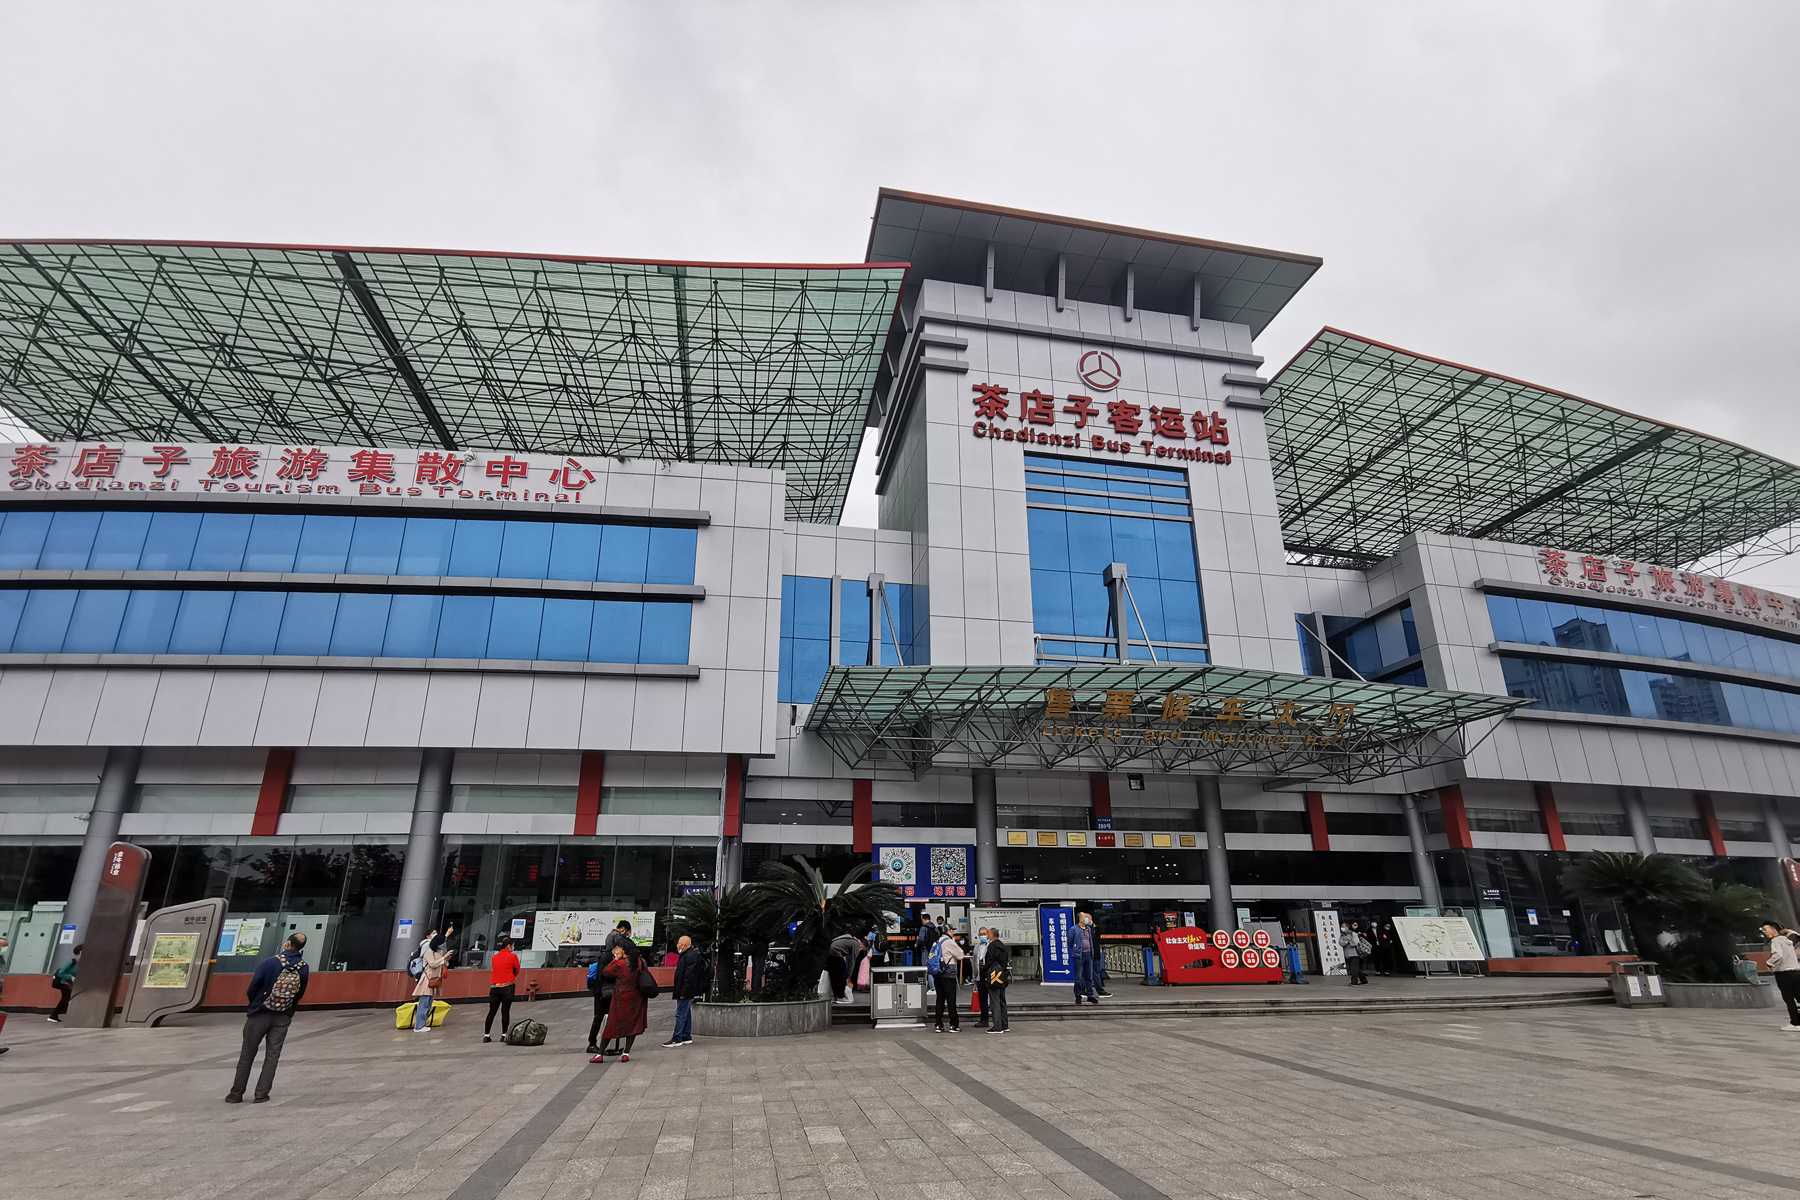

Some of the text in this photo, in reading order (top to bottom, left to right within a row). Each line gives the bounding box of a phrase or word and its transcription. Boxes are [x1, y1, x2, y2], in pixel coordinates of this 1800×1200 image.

[972, 382, 1230, 446] 茶店子客运站
[973, 421, 1232, 465] Chadianzi Bus Terminal
[8, 444, 596, 491] 茶店子旅游集散中心
[9, 478, 582, 504] Chadianzi Tourism Bus Terminal
